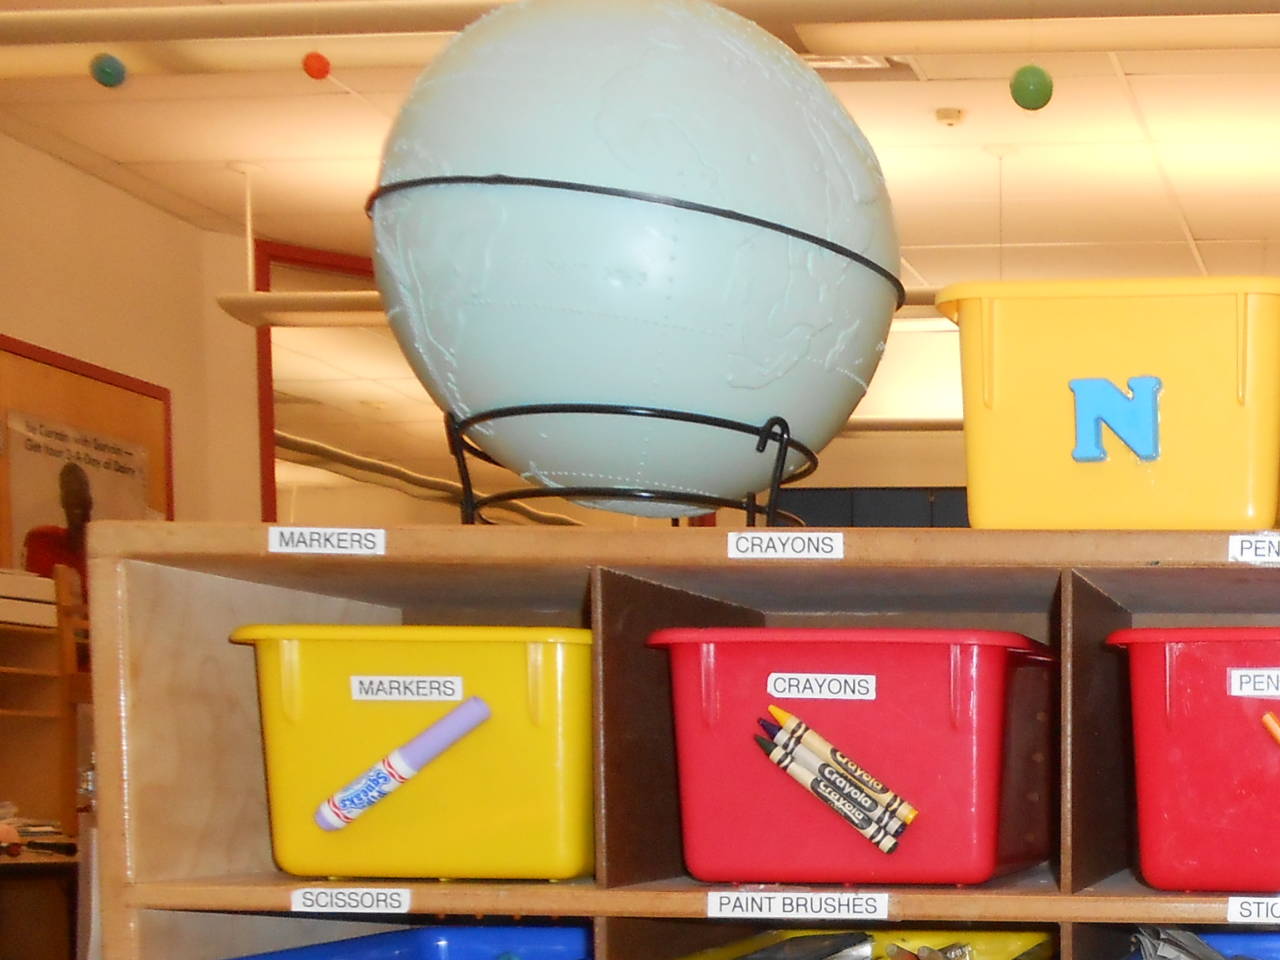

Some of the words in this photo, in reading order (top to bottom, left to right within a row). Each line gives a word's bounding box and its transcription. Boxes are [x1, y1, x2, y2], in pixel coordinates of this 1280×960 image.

[1068, 375, 1162, 462] N
[279, 532, 376, 550] MARKERS
[735, 537, 834, 553] CRAYONS
[359, 680, 455, 696] MARKERS
[773, 677, 870, 695] CRAYONS
[338, 769, 391, 811] Squeaks
[823, 765, 873, 808] Crayola
[818, 779, 865, 821] Crayola
[302, 891, 402, 908] SCISSORS
[719, 896, 776, 912] PAINT
[782, 897, 877, 913] BRUSHES
